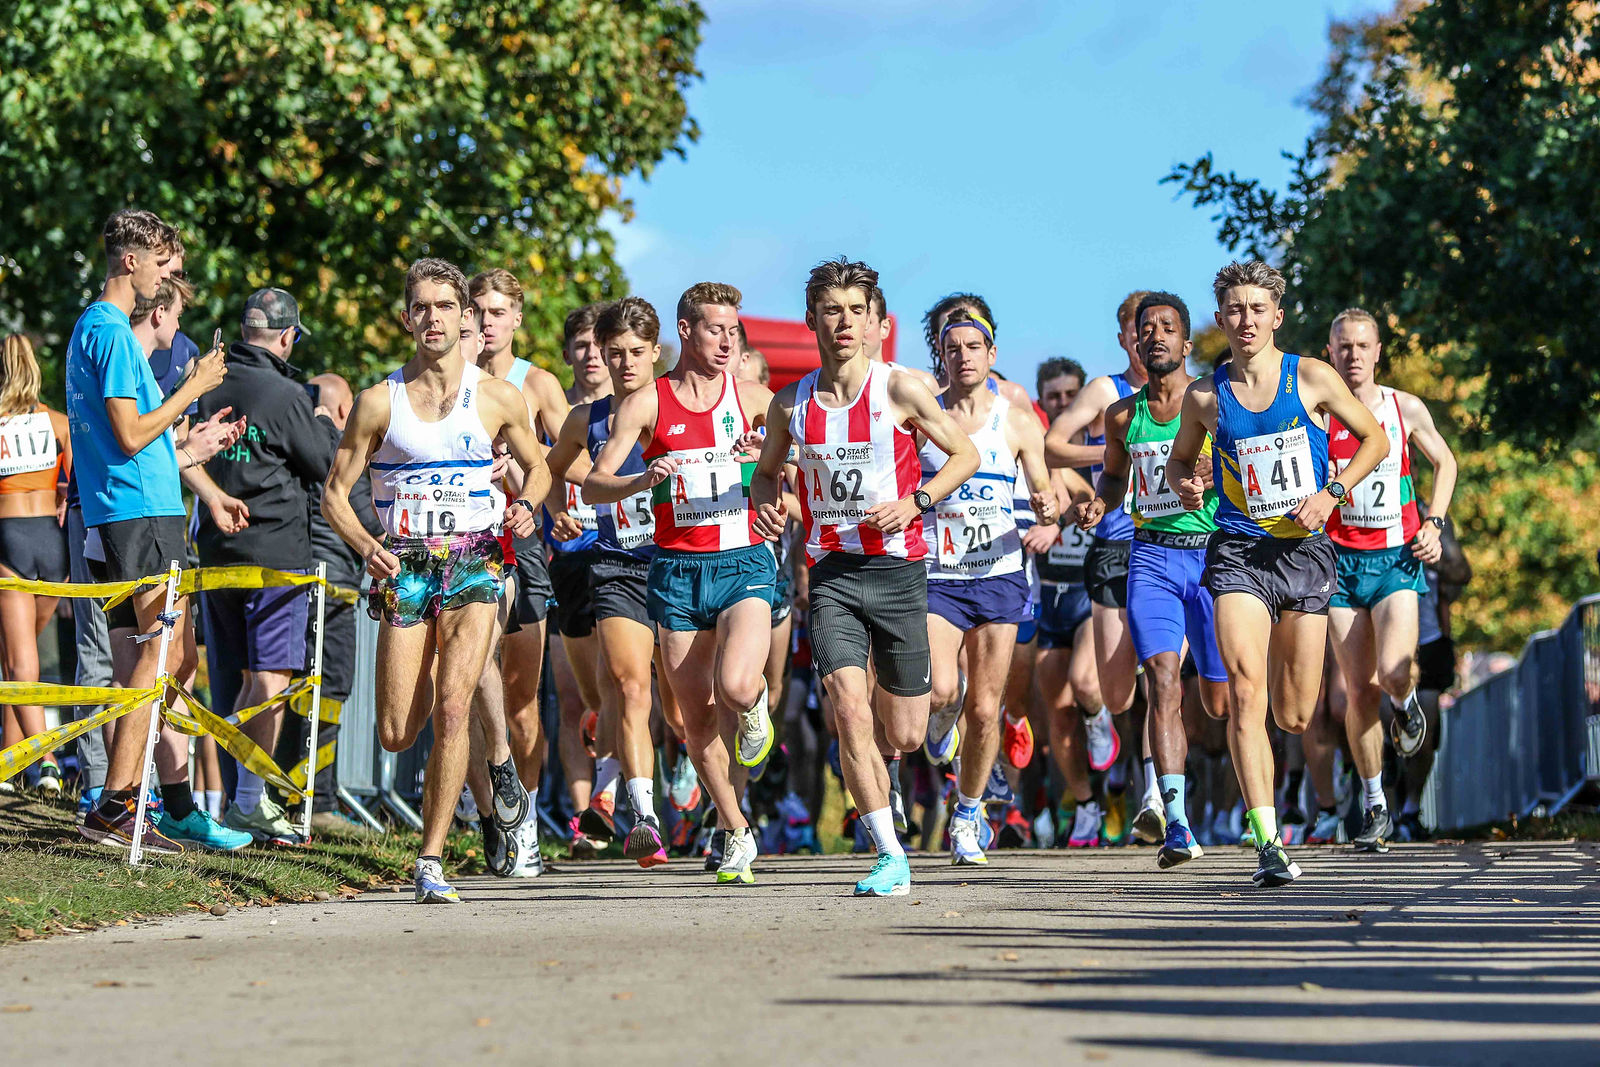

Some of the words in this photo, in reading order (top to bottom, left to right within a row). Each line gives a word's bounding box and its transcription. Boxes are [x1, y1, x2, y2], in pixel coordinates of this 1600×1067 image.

[1285, 373, 1294, 394] soar
[463, 387, 472, 409] soar
[1, 435, 11, 459] A
[15, 430, 50, 457] 117
[1285, 433, 1305, 444] START
[847, 448, 870, 456] START
[1132, 450, 1159, 459] E.R.R.A.
[1238, 444, 1273, 457] E.R.R.A.
[427, 473, 443, 486] &
[813, 468, 824, 502] A
[830, 468, 865, 502] 62
[1138, 466, 1149, 497] A
[1247, 464, 1262, 497] A
[1270, 456, 1302, 492] 41
[397, 492, 430, 501] E.R.R.A.
[443, 490, 466, 498] START
[567, 484, 578, 511] A
[675, 474, 689, 505] A
[710, 472, 719, 502] 1
[958, 483, 975, 501] &
[979, 485, 994, 501] C
[1371, 481, 1385, 508] 2
[399, 508, 411, 538] A
[426, 510, 456, 538] 19
[617, 500, 631, 530] A
[676, 507, 742, 521] BIRMINGHAM
[1342, 512, 1400, 522] BIRMINGHAM
[943, 526, 956, 555] A
[962, 523, 992, 554] 20
